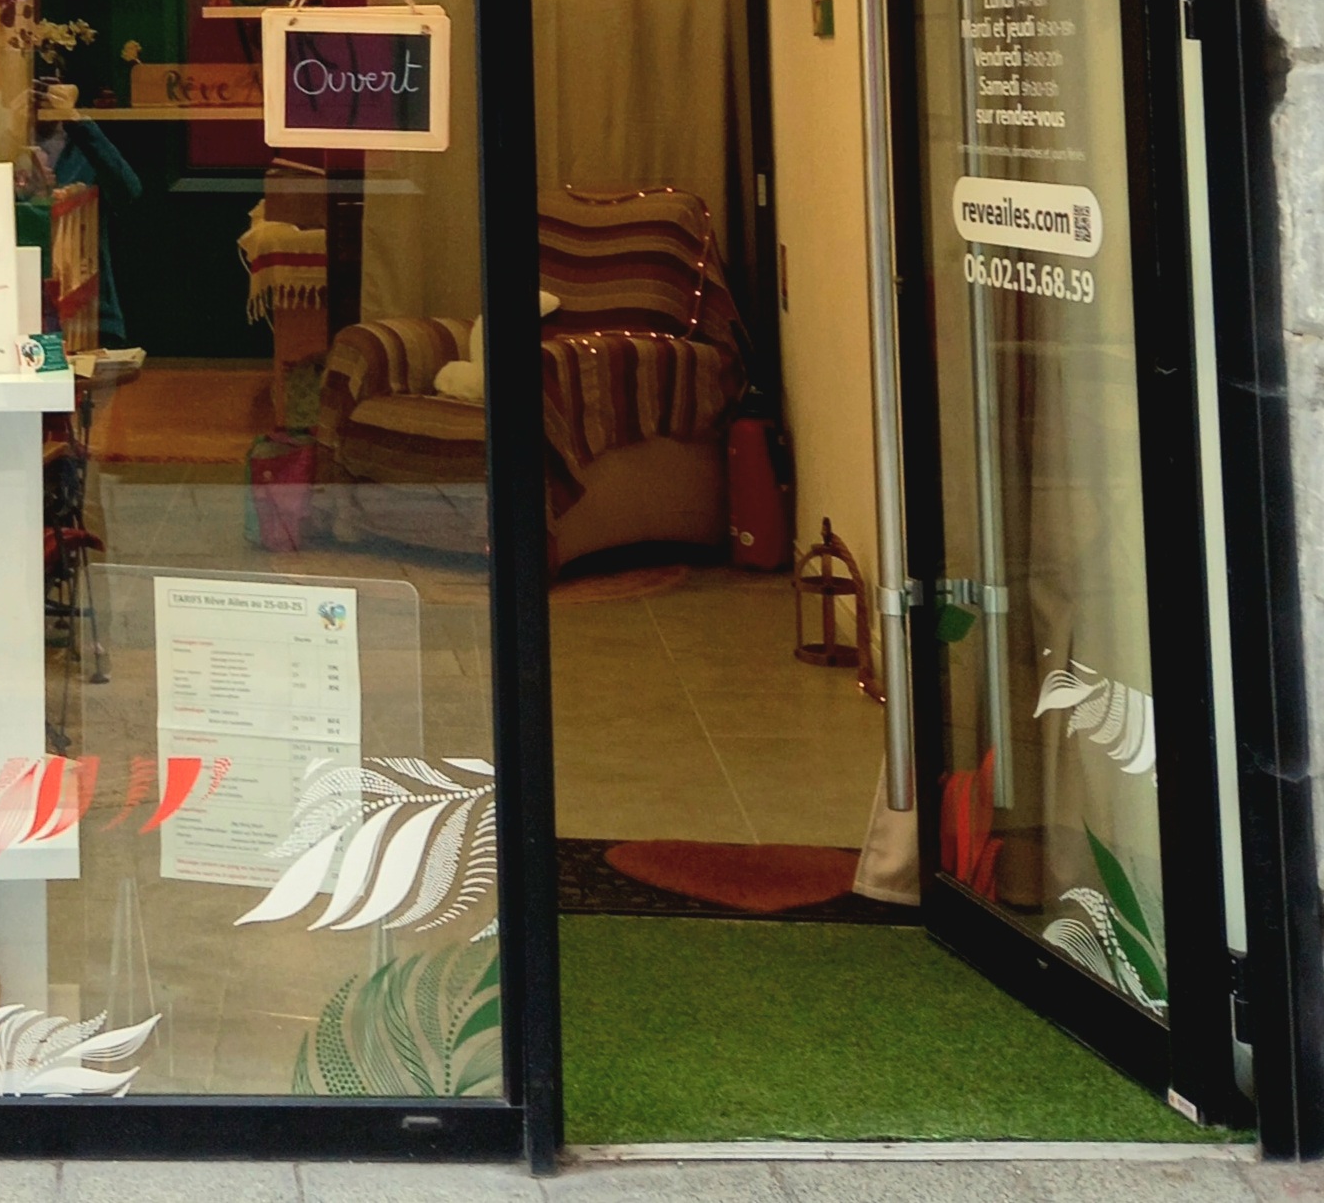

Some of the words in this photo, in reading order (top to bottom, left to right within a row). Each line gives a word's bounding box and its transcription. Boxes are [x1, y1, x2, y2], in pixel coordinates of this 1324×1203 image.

[961, 16, 992, 39] Mardi
[993, 18, 1006, 38] et
[1006, 15, 1036, 44] jeudi
[972, 44, 1023, 68] Vendredi
[293, 49, 423, 95] Ouvert
[979, 74, 1020, 96] Samedi
[975, 108, 994, 125] sur
[995, 103, 1066, 128] rendez-vous
[961, 197, 1072, 235] reveailes.com
[963, 252, 1095, 304] 06.02.15.68.59
[204, 594, 226, 607] Rêve
